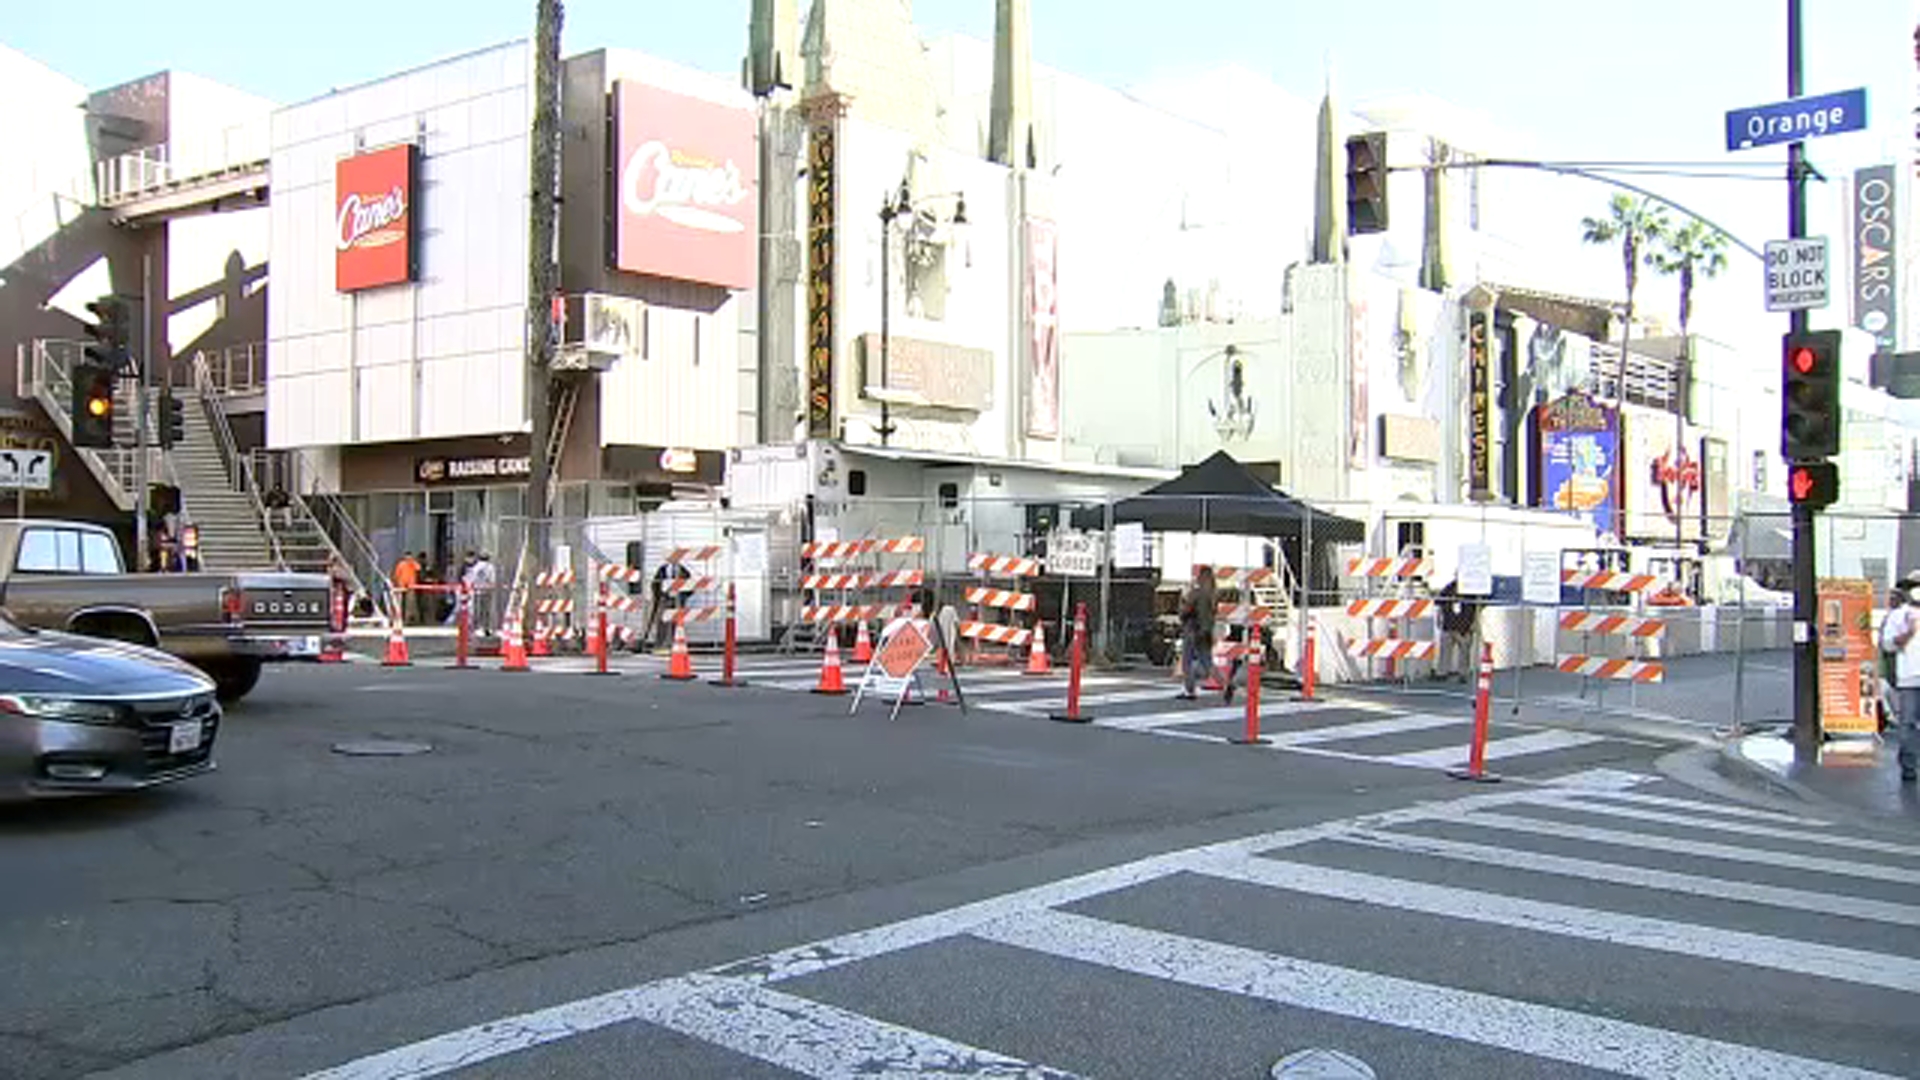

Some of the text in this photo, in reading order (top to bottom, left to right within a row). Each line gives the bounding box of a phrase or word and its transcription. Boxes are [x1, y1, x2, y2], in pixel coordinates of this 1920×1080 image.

[1748, 106, 1844, 138] Orange
[624, 139, 749, 216] Cane's
[337, 185, 408, 251] Cane's
[1859, 178, 1891, 301] OSCARS
[1769, 245, 1824, 267] DO NOT
[1769, 269, 1825, 289] BLOCK
[1050, 555, 1093, 572] CLOSED
[254, 602, 319, 614] DODGE
